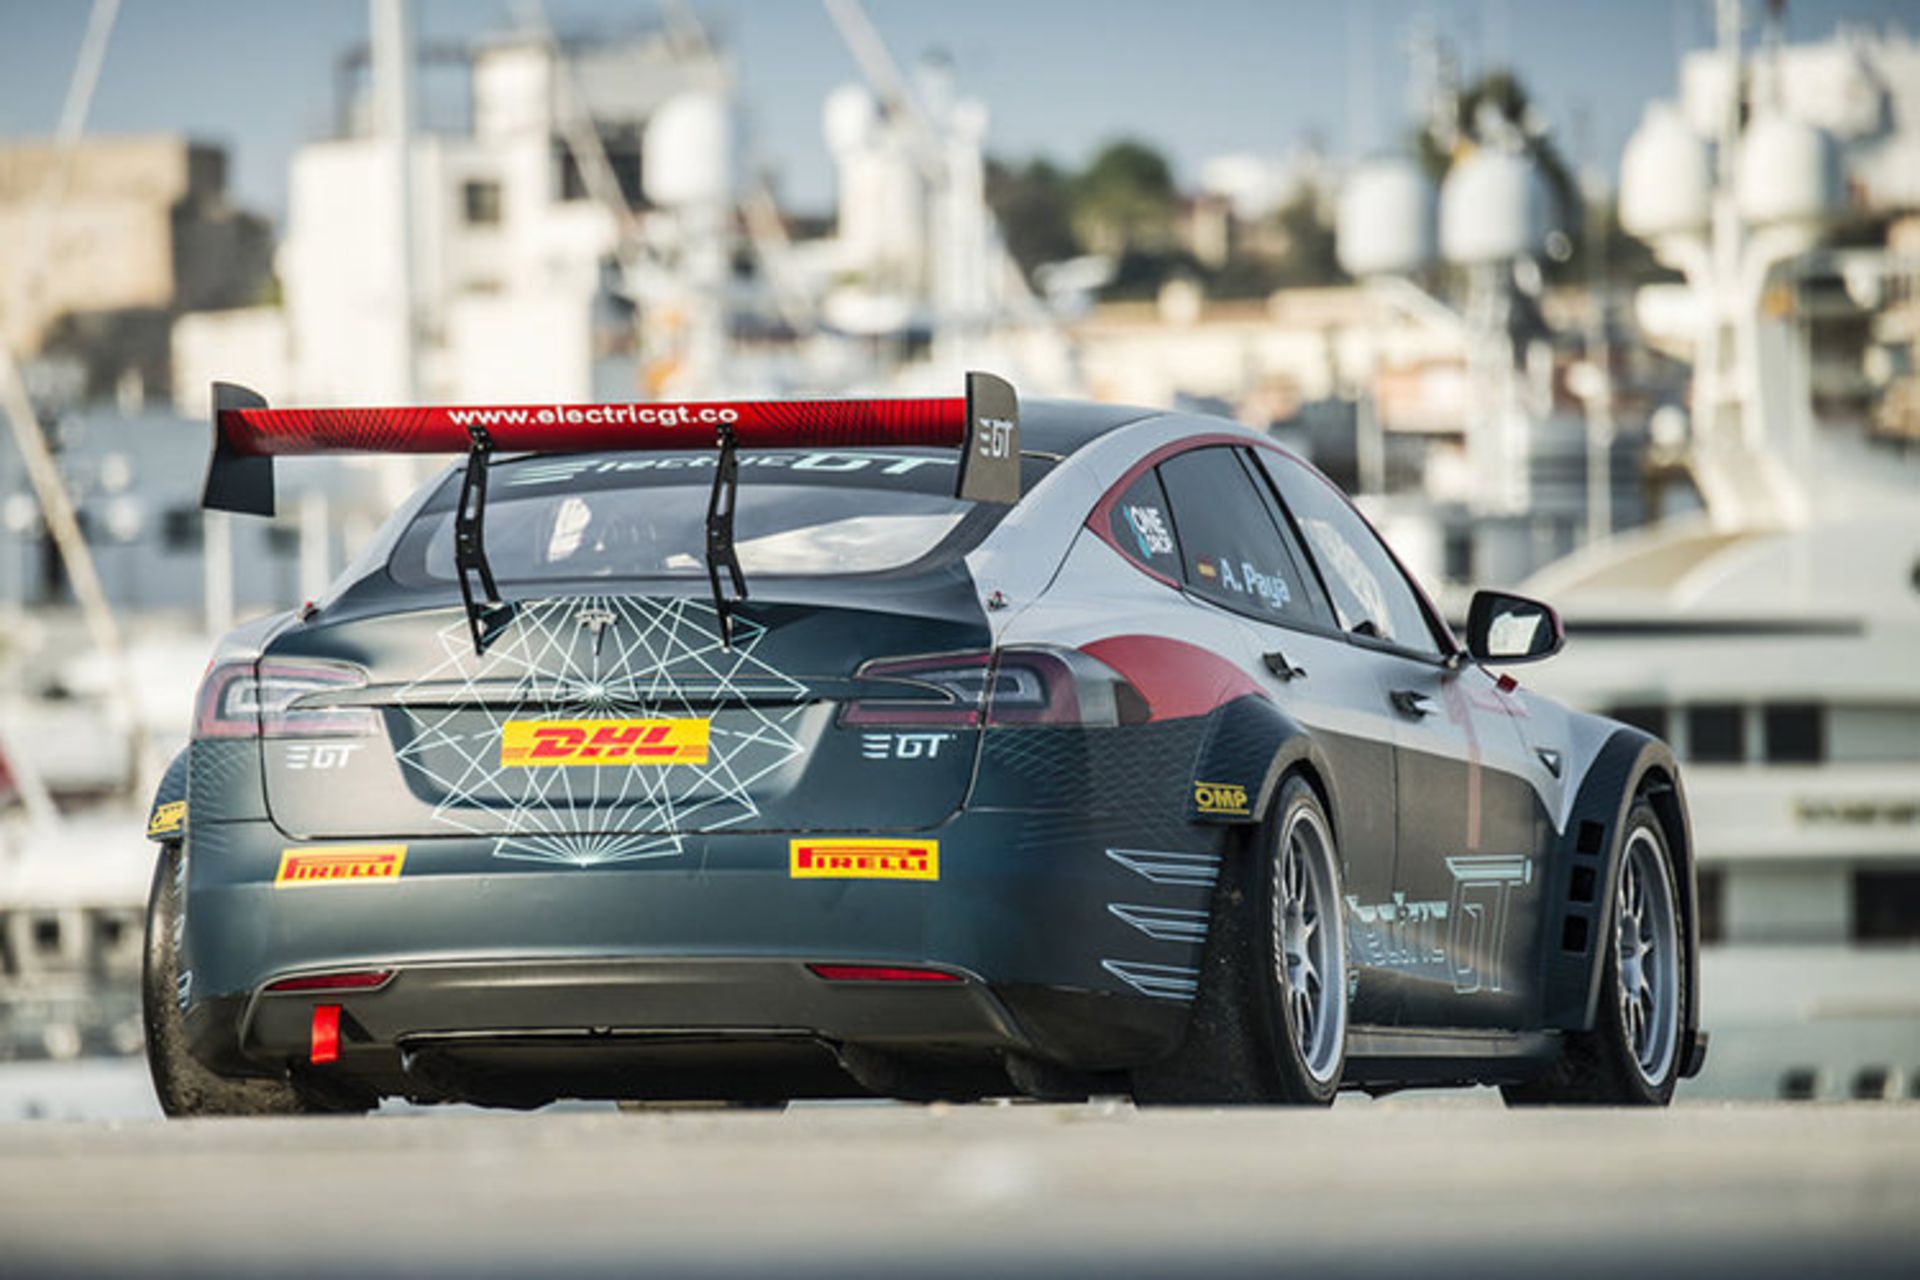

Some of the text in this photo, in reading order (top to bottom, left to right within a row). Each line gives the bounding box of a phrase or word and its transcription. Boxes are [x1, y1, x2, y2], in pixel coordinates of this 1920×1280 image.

[449, 404, 739, 427] www.electricgt.co
[1219, 558, 1243, 592] A.
[530, 726, 678, 759] DHL
[1195, 785, 1249, 810] OMP
[283, 853, 397, 880] PIRELLI
[797, 846, 928, 872] PIRELLI
